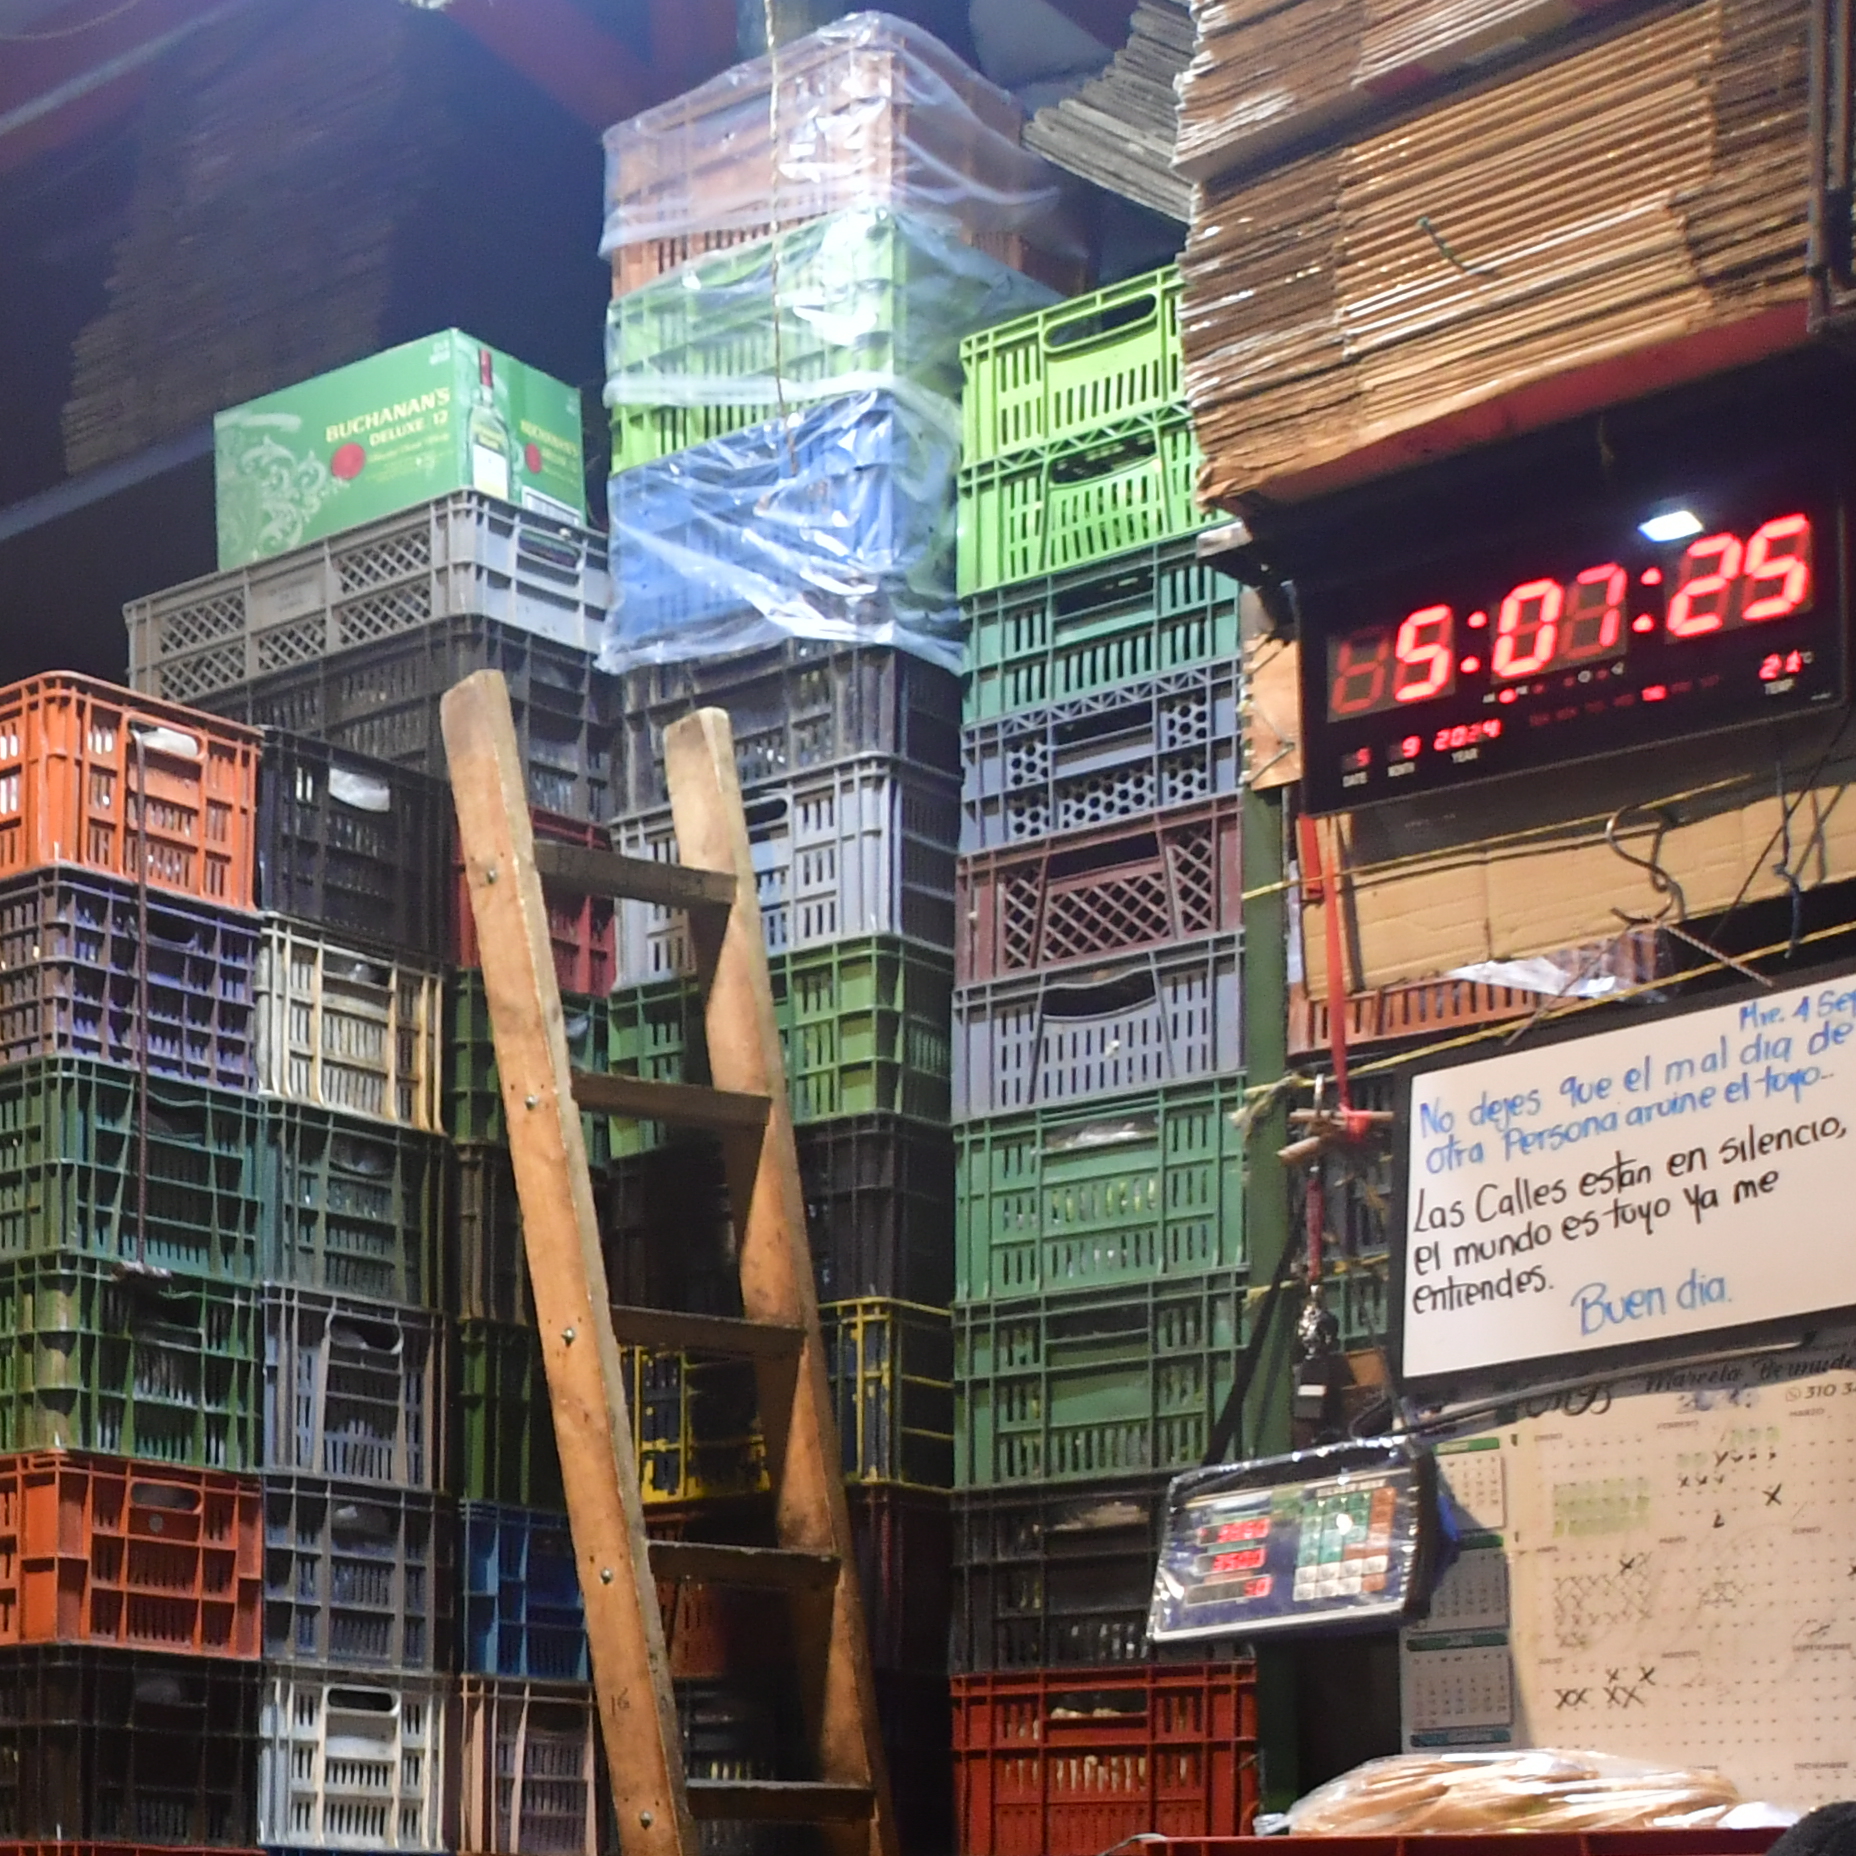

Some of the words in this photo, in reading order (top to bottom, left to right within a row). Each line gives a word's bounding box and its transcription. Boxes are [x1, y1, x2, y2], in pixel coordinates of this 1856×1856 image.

[369, 417, 424, 447] DELUXE
[1402, 734, 1423, 759] 9
[1419, 1097, 1455, 1139] No
[1559, 1075, 1613, 1109] que
[1623, 1055, 1652, 1093] el
[1664, 1035, 1727, 1086] mal
[1807, 1020, 1855, 1056] de
[1724, 1071, 1750, 1104] el
[1414, 1187, 1466, 1233] Las
[1474, 1176, 1568, 1224] Calles
[1666, 1147, 1709, 1178] en
[1414, 1240, 1442, 1277] el
[1453, 1220, 1553, 1268] mundo
[1561, 1209, 1600, 1242] es
[1733, 1170, 1780, 1206] me
[1412, 1264, 1556, 1315] entiendes.
[1570, 1280, 1667, 1337] Buen
